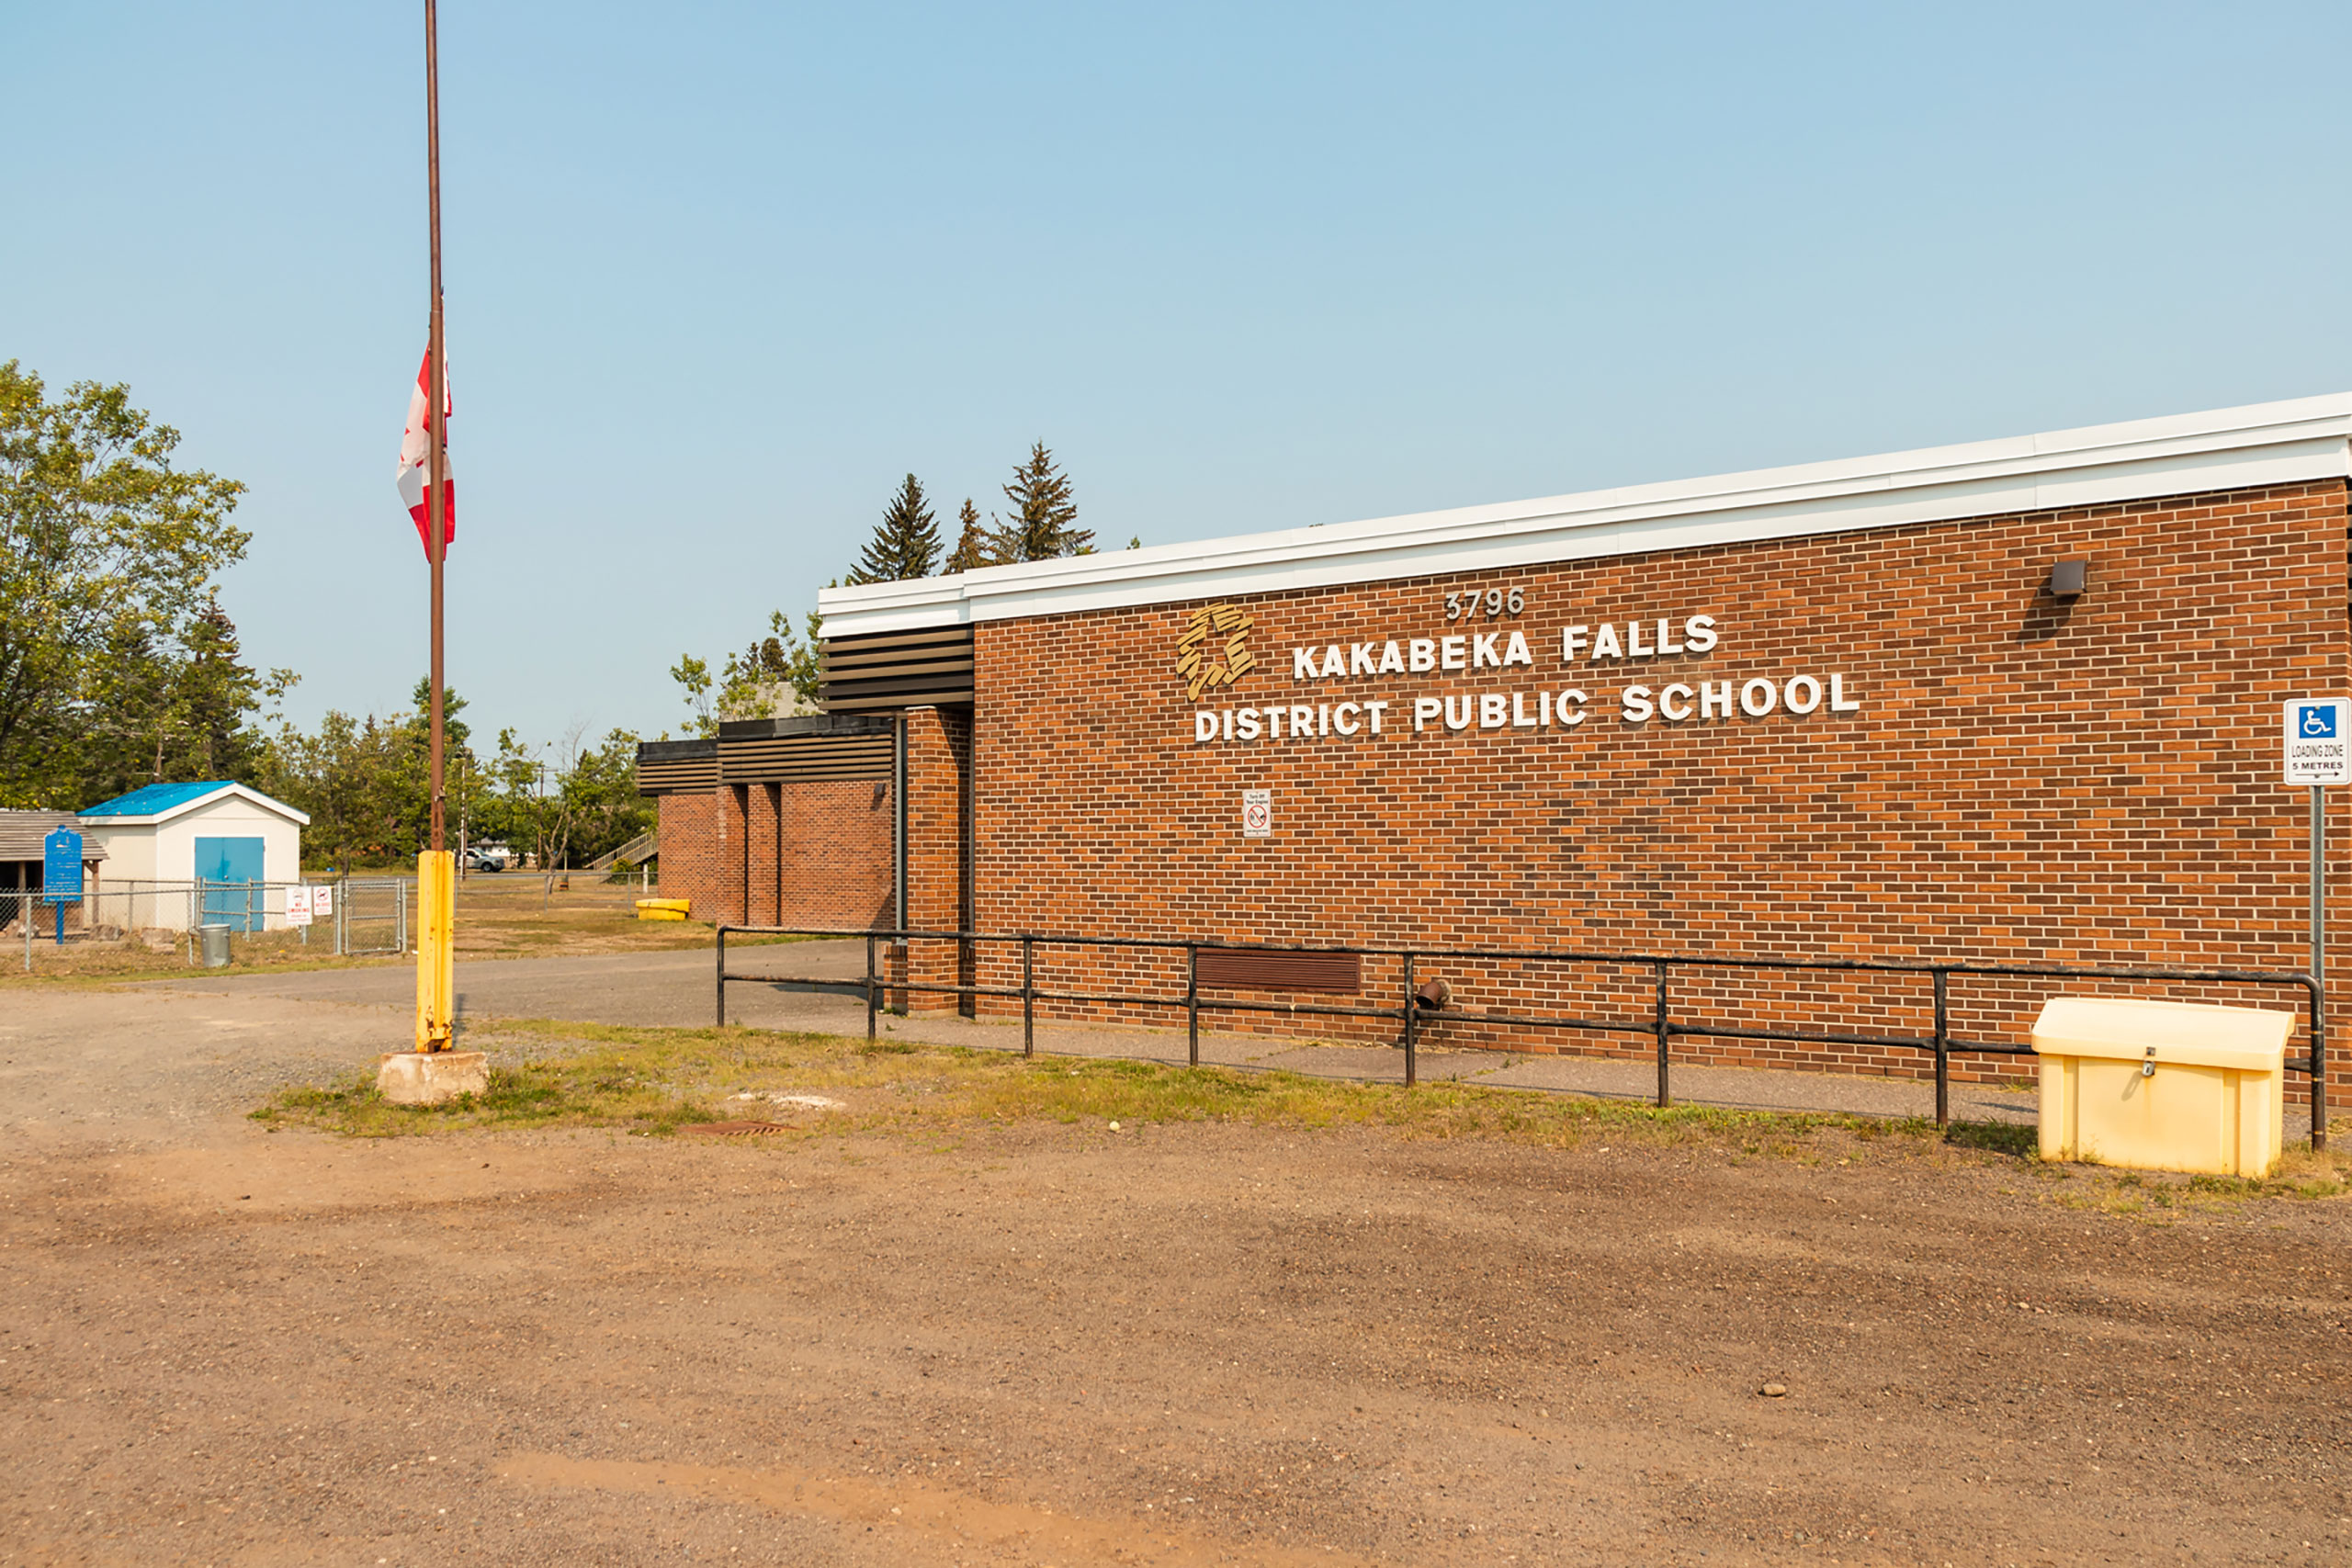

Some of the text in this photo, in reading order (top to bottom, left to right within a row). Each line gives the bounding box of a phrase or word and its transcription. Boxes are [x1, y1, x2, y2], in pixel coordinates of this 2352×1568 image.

[1445, 587, 1525, 620] 3796
[1294, 615, 1718, 680] KAKABEKA FALLS
[1195, 673, 1860, 742] DISTRICT PUBLIC SCHOOL
[2291, 744, 2344, 758] LOADING ZONE
[2301, 761, 2344, 770] METRES
